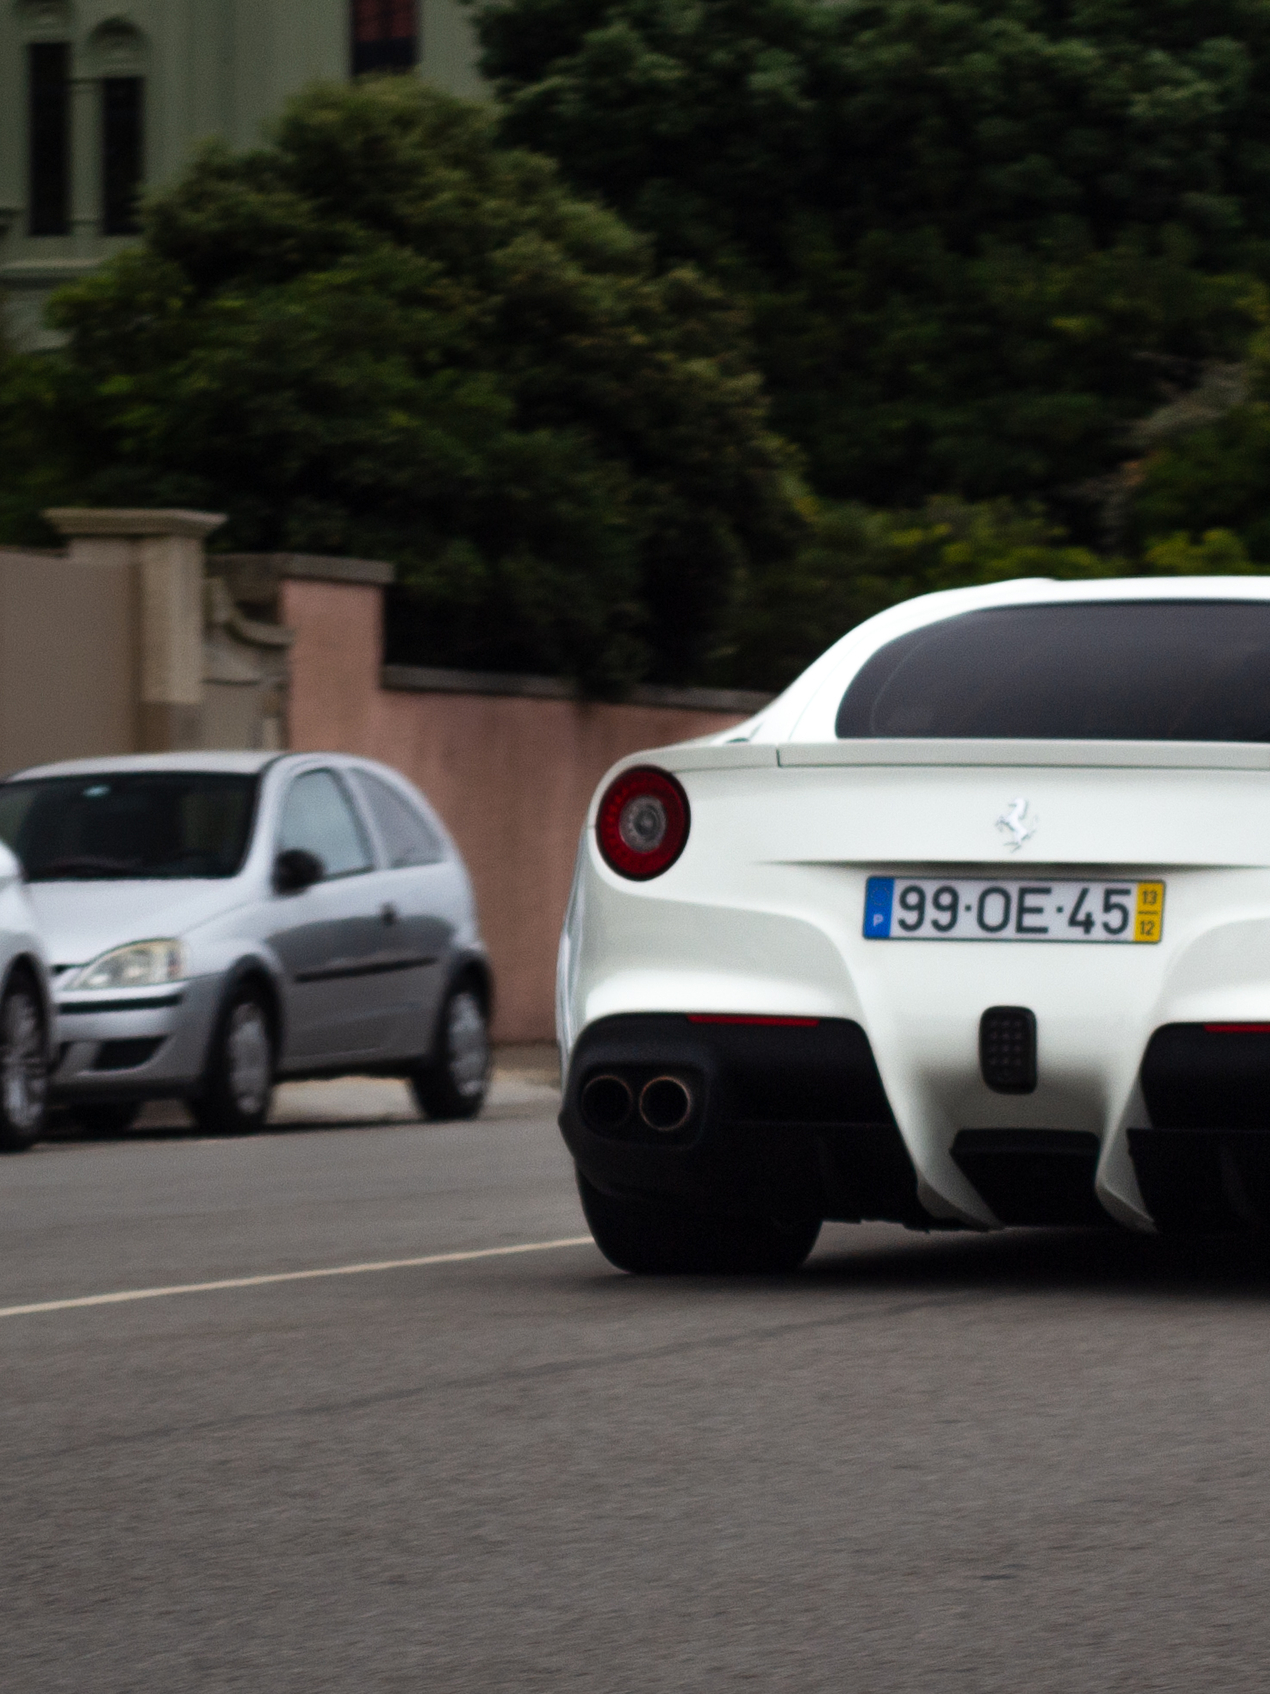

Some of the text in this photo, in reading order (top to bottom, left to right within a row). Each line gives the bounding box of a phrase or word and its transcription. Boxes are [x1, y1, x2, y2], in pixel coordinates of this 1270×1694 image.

[1141, 890, 1158, 905] 13
[873, 913, 884, 927] P
[1139, 920, 1155, 936] 12
